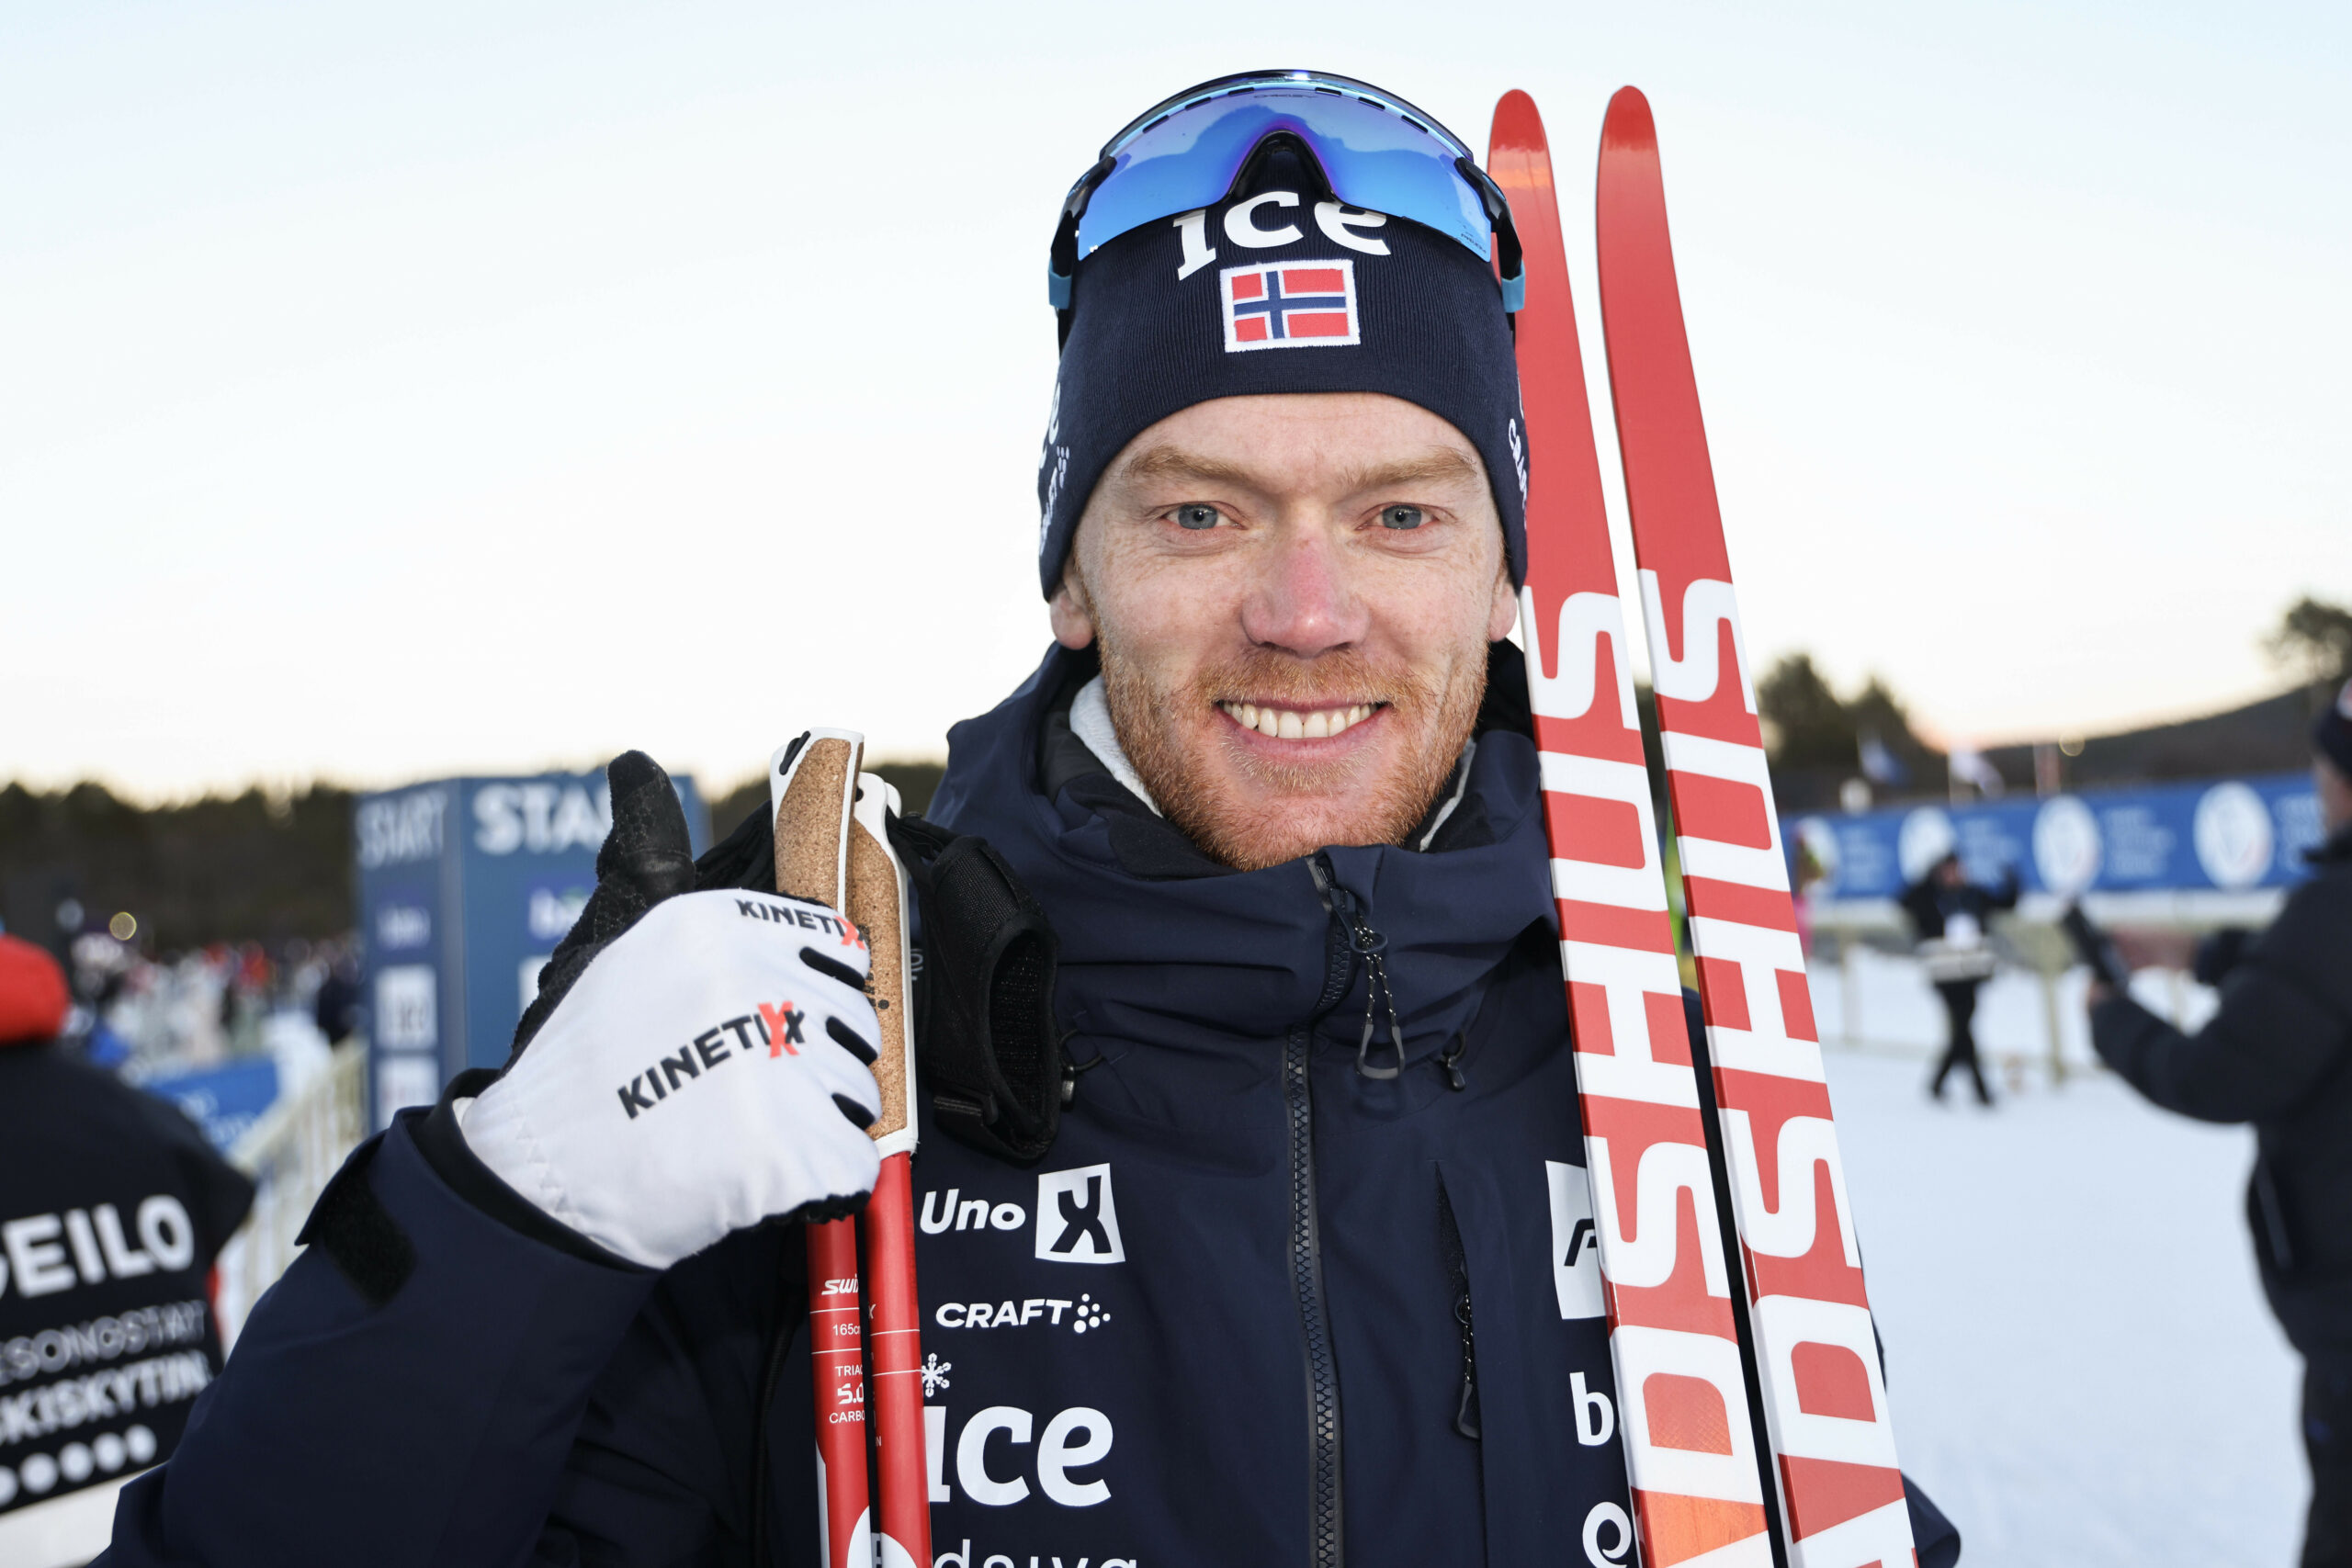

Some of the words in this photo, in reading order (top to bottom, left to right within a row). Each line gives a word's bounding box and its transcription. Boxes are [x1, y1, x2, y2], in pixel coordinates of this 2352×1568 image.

[471, 783, 614, 854] STA
[735, 899, 866, 950] KINETIX
[1521, 585, 1777, 1568] DSHUS
[0, 1193, 195, 1299] EILO
[920, 1189, 1026, 1235] Uno
[1049, 1174, 1114, 1255] X
[935, 1299, 1072, 1329] CRAFT
[829, 1410, 865, 1424] CARBO
